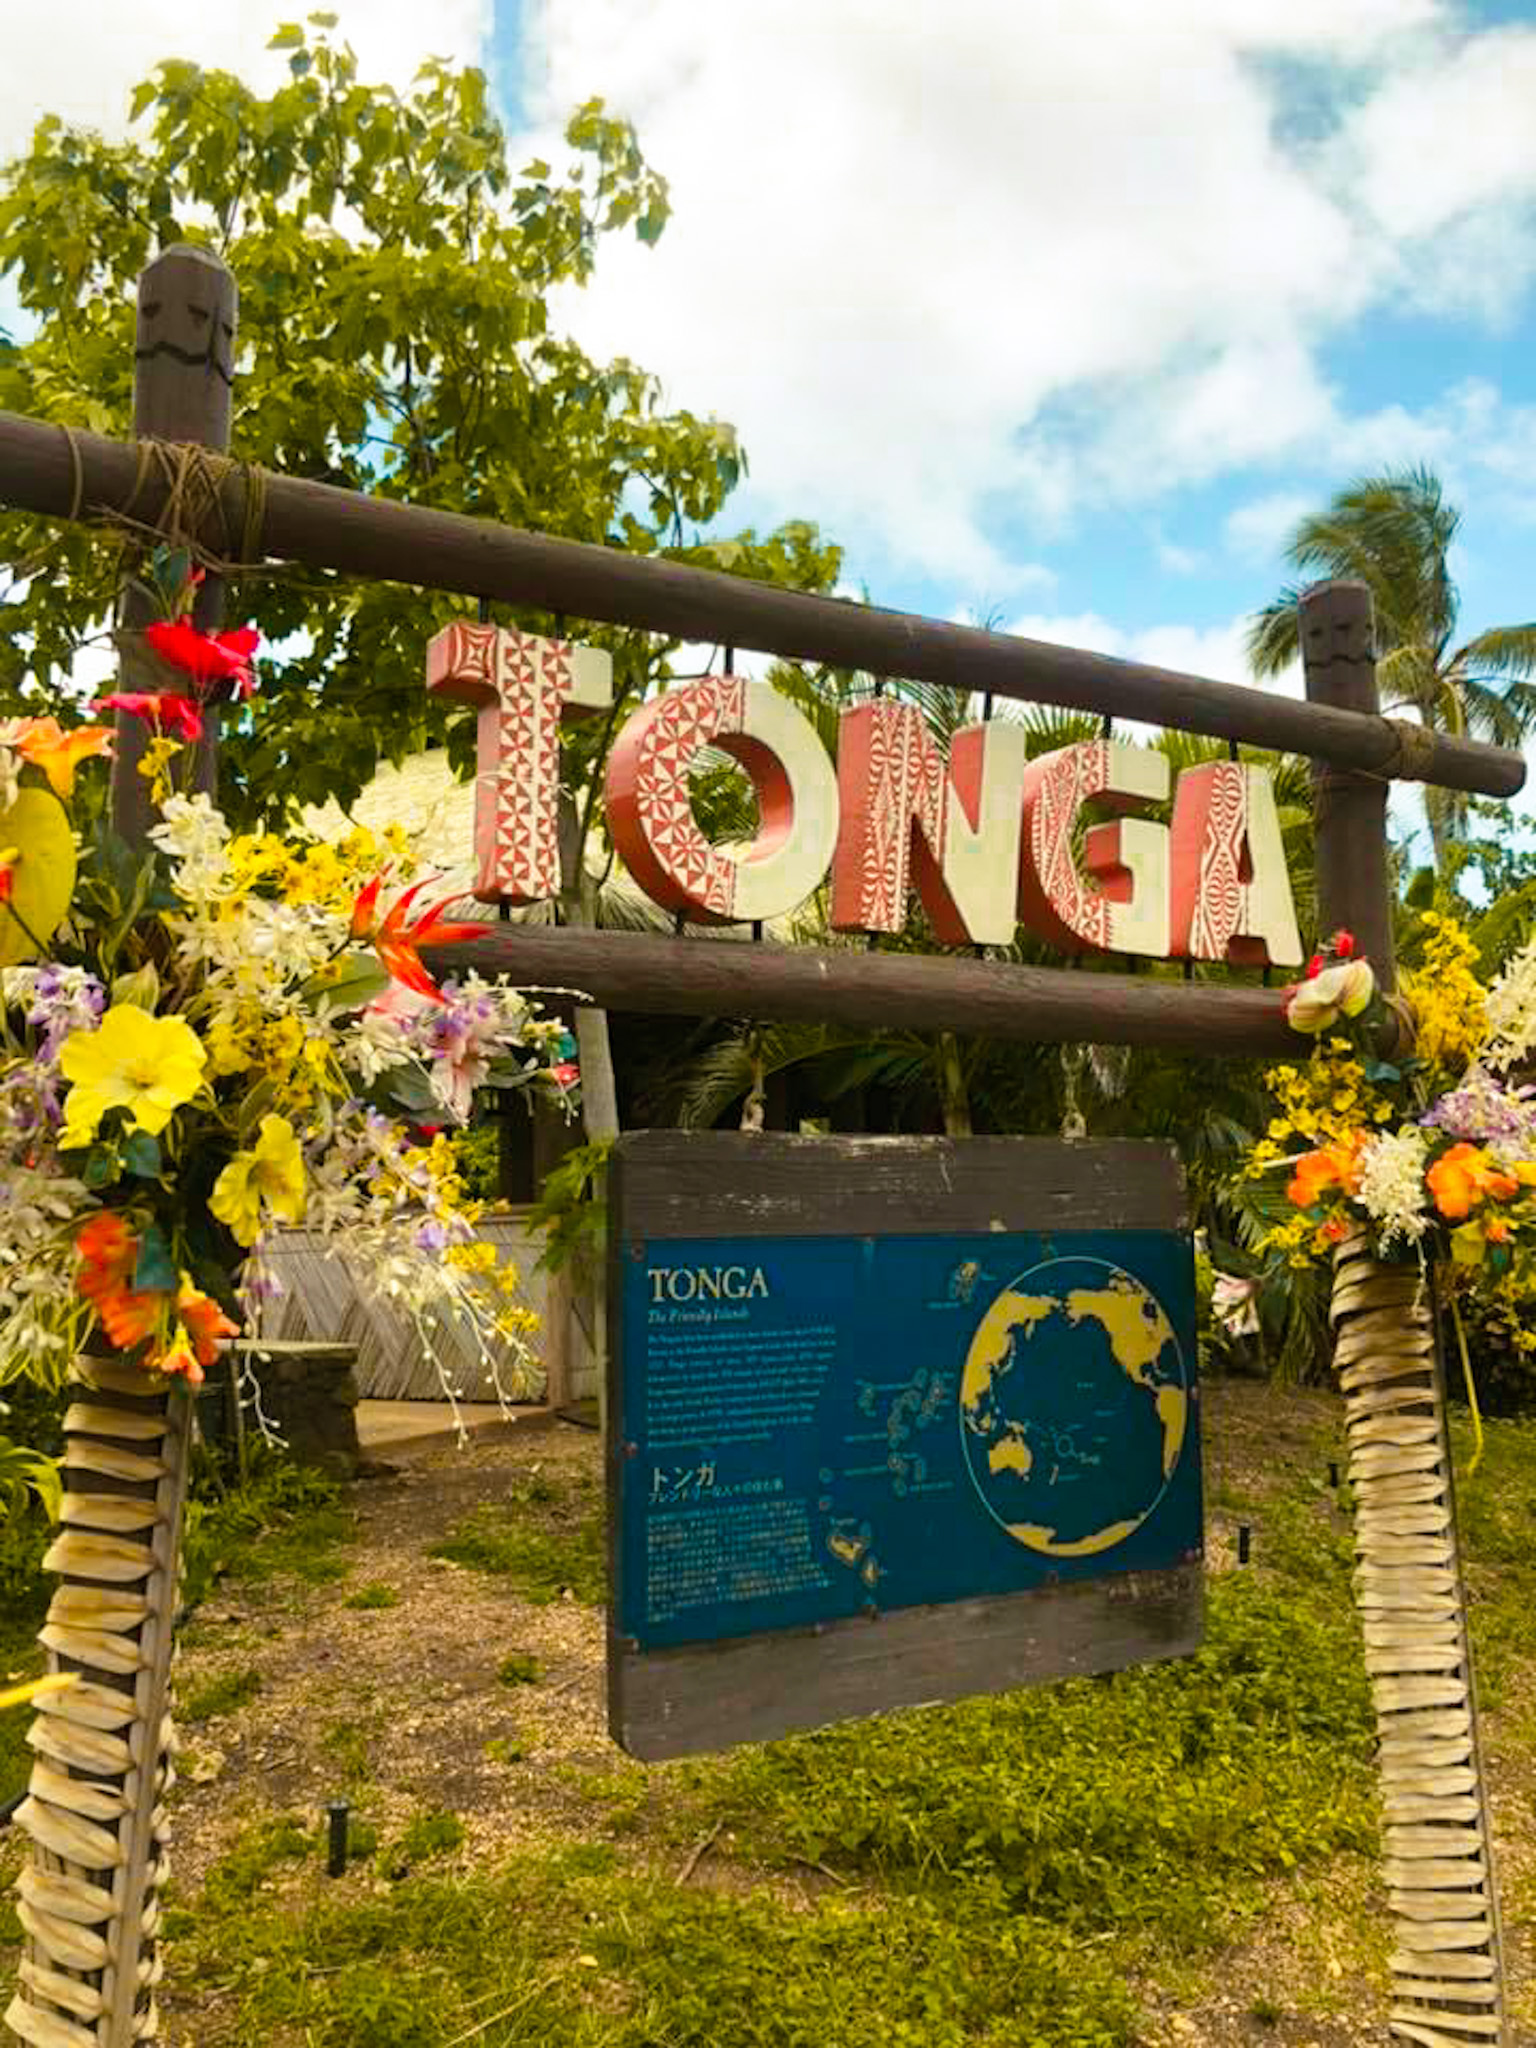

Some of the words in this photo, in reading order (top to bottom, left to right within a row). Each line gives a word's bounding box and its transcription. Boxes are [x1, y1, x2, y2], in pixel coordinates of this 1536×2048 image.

[426, 620, 1302, 968] TONGA
[648, 1266, 769, 1302] TONGA
[648, 1309, 666, 1324] The
[668, 1308, 712, 1326] Friendly
[653, 1460, 717, 1493] トンガ
